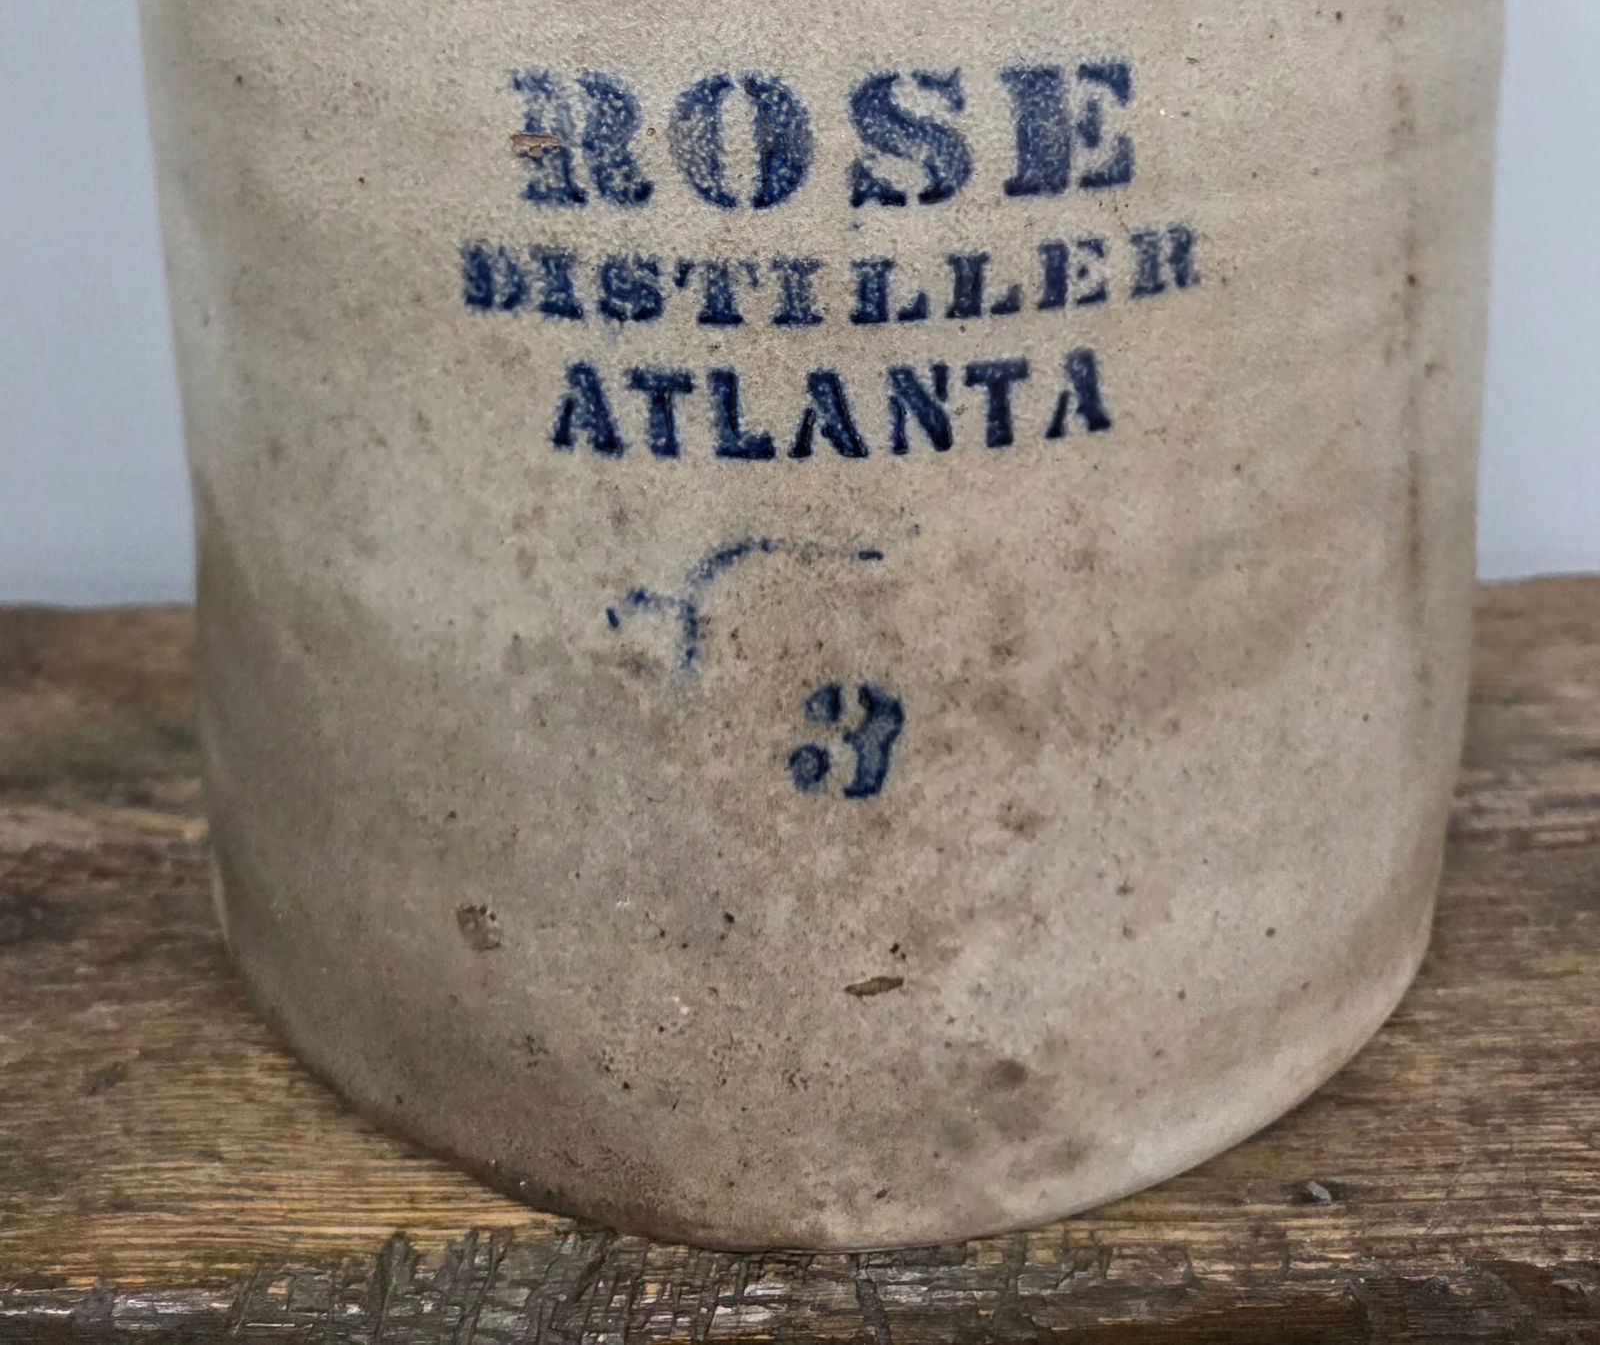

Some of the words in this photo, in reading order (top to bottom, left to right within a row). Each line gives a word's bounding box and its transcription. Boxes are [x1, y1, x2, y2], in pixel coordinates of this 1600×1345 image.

[510, 61, 1134, 208] ROSE
[460, 222, 1200, 325] DISTILLER
[550, 347, 1112, 459] ATLANTA
[788, 682, 905, 799] 3
